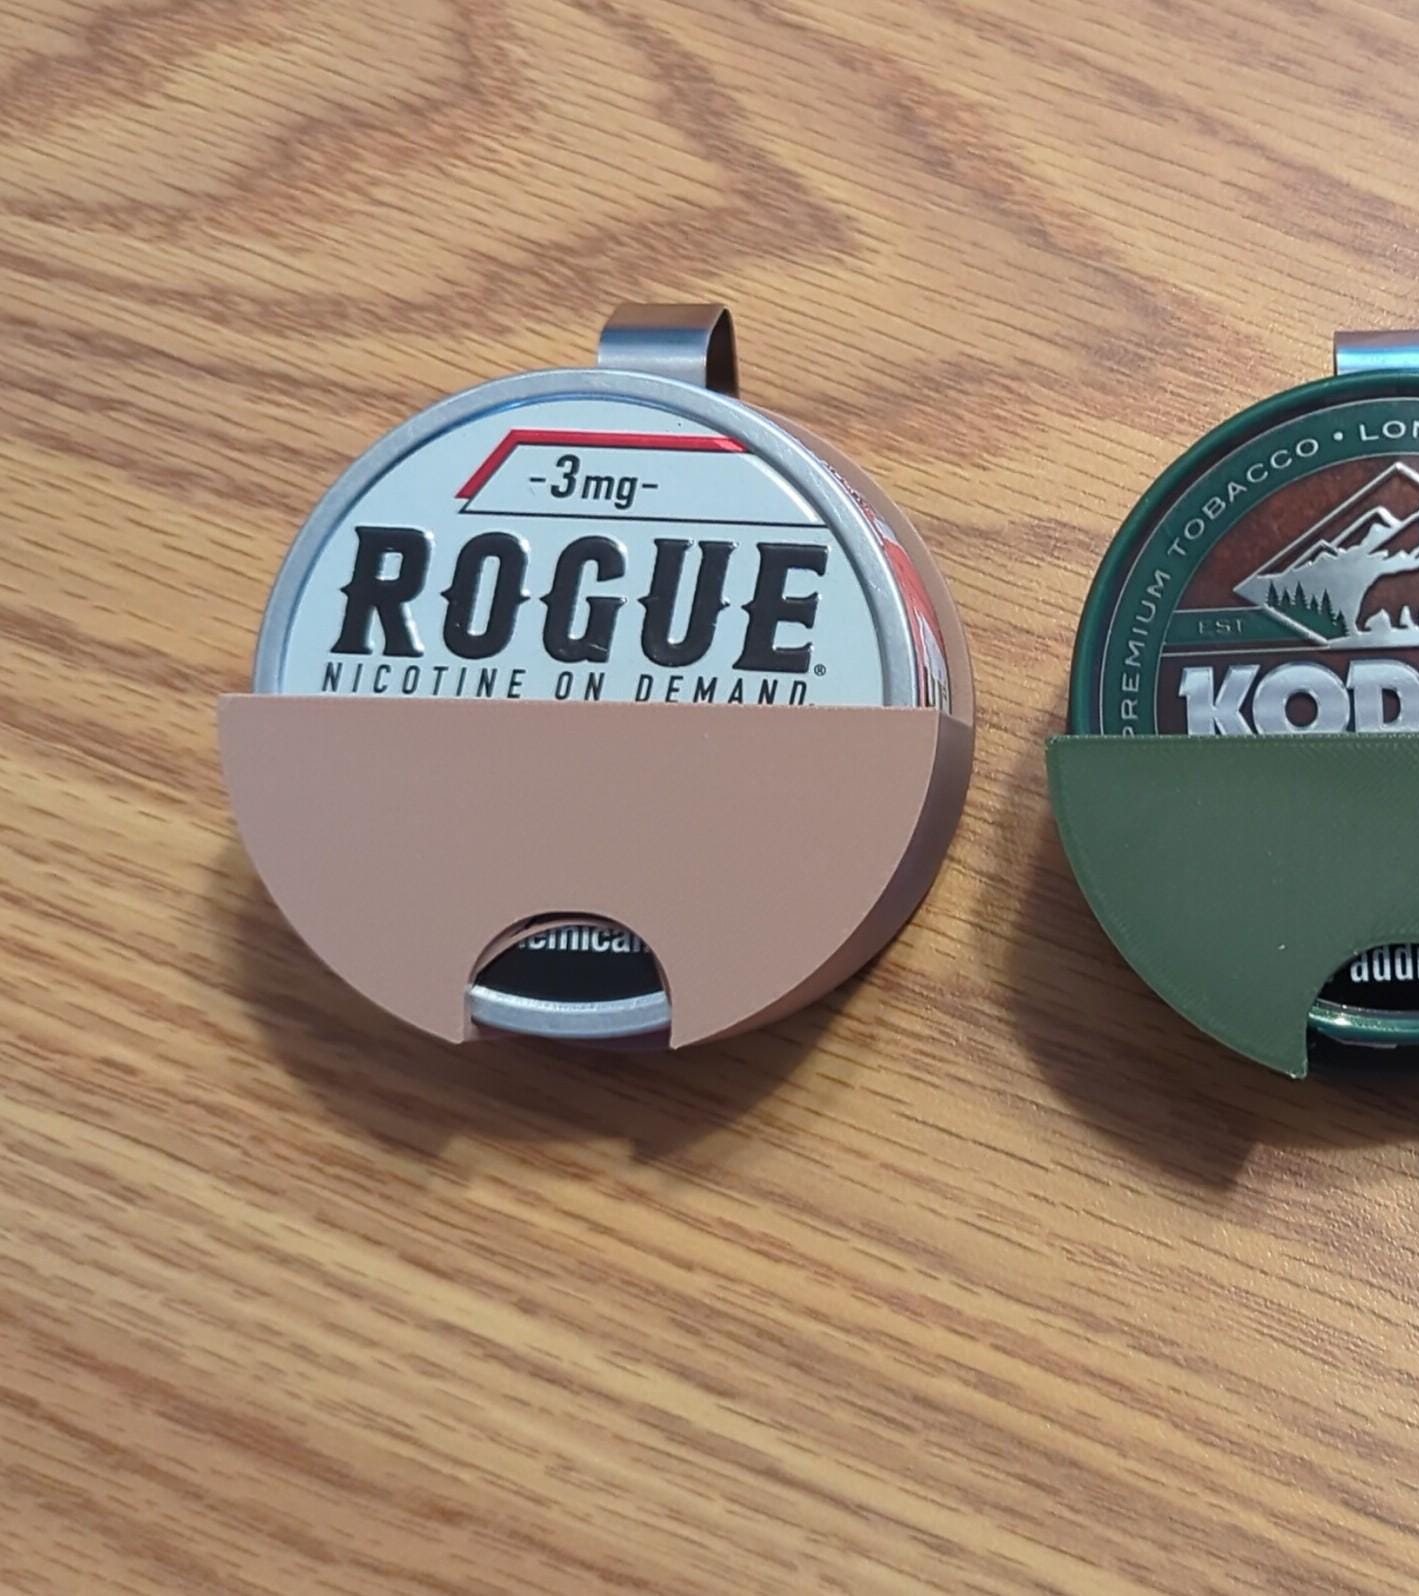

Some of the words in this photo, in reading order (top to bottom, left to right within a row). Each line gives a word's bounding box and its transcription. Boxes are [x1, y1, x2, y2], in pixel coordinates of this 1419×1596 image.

[1167, 437, 1320, 559] TOBACCO
[329, 525, 832, 677] ROGUE
[321, 661, 527, 699] NICOTINE
[554, 670, 605, 702] ON
